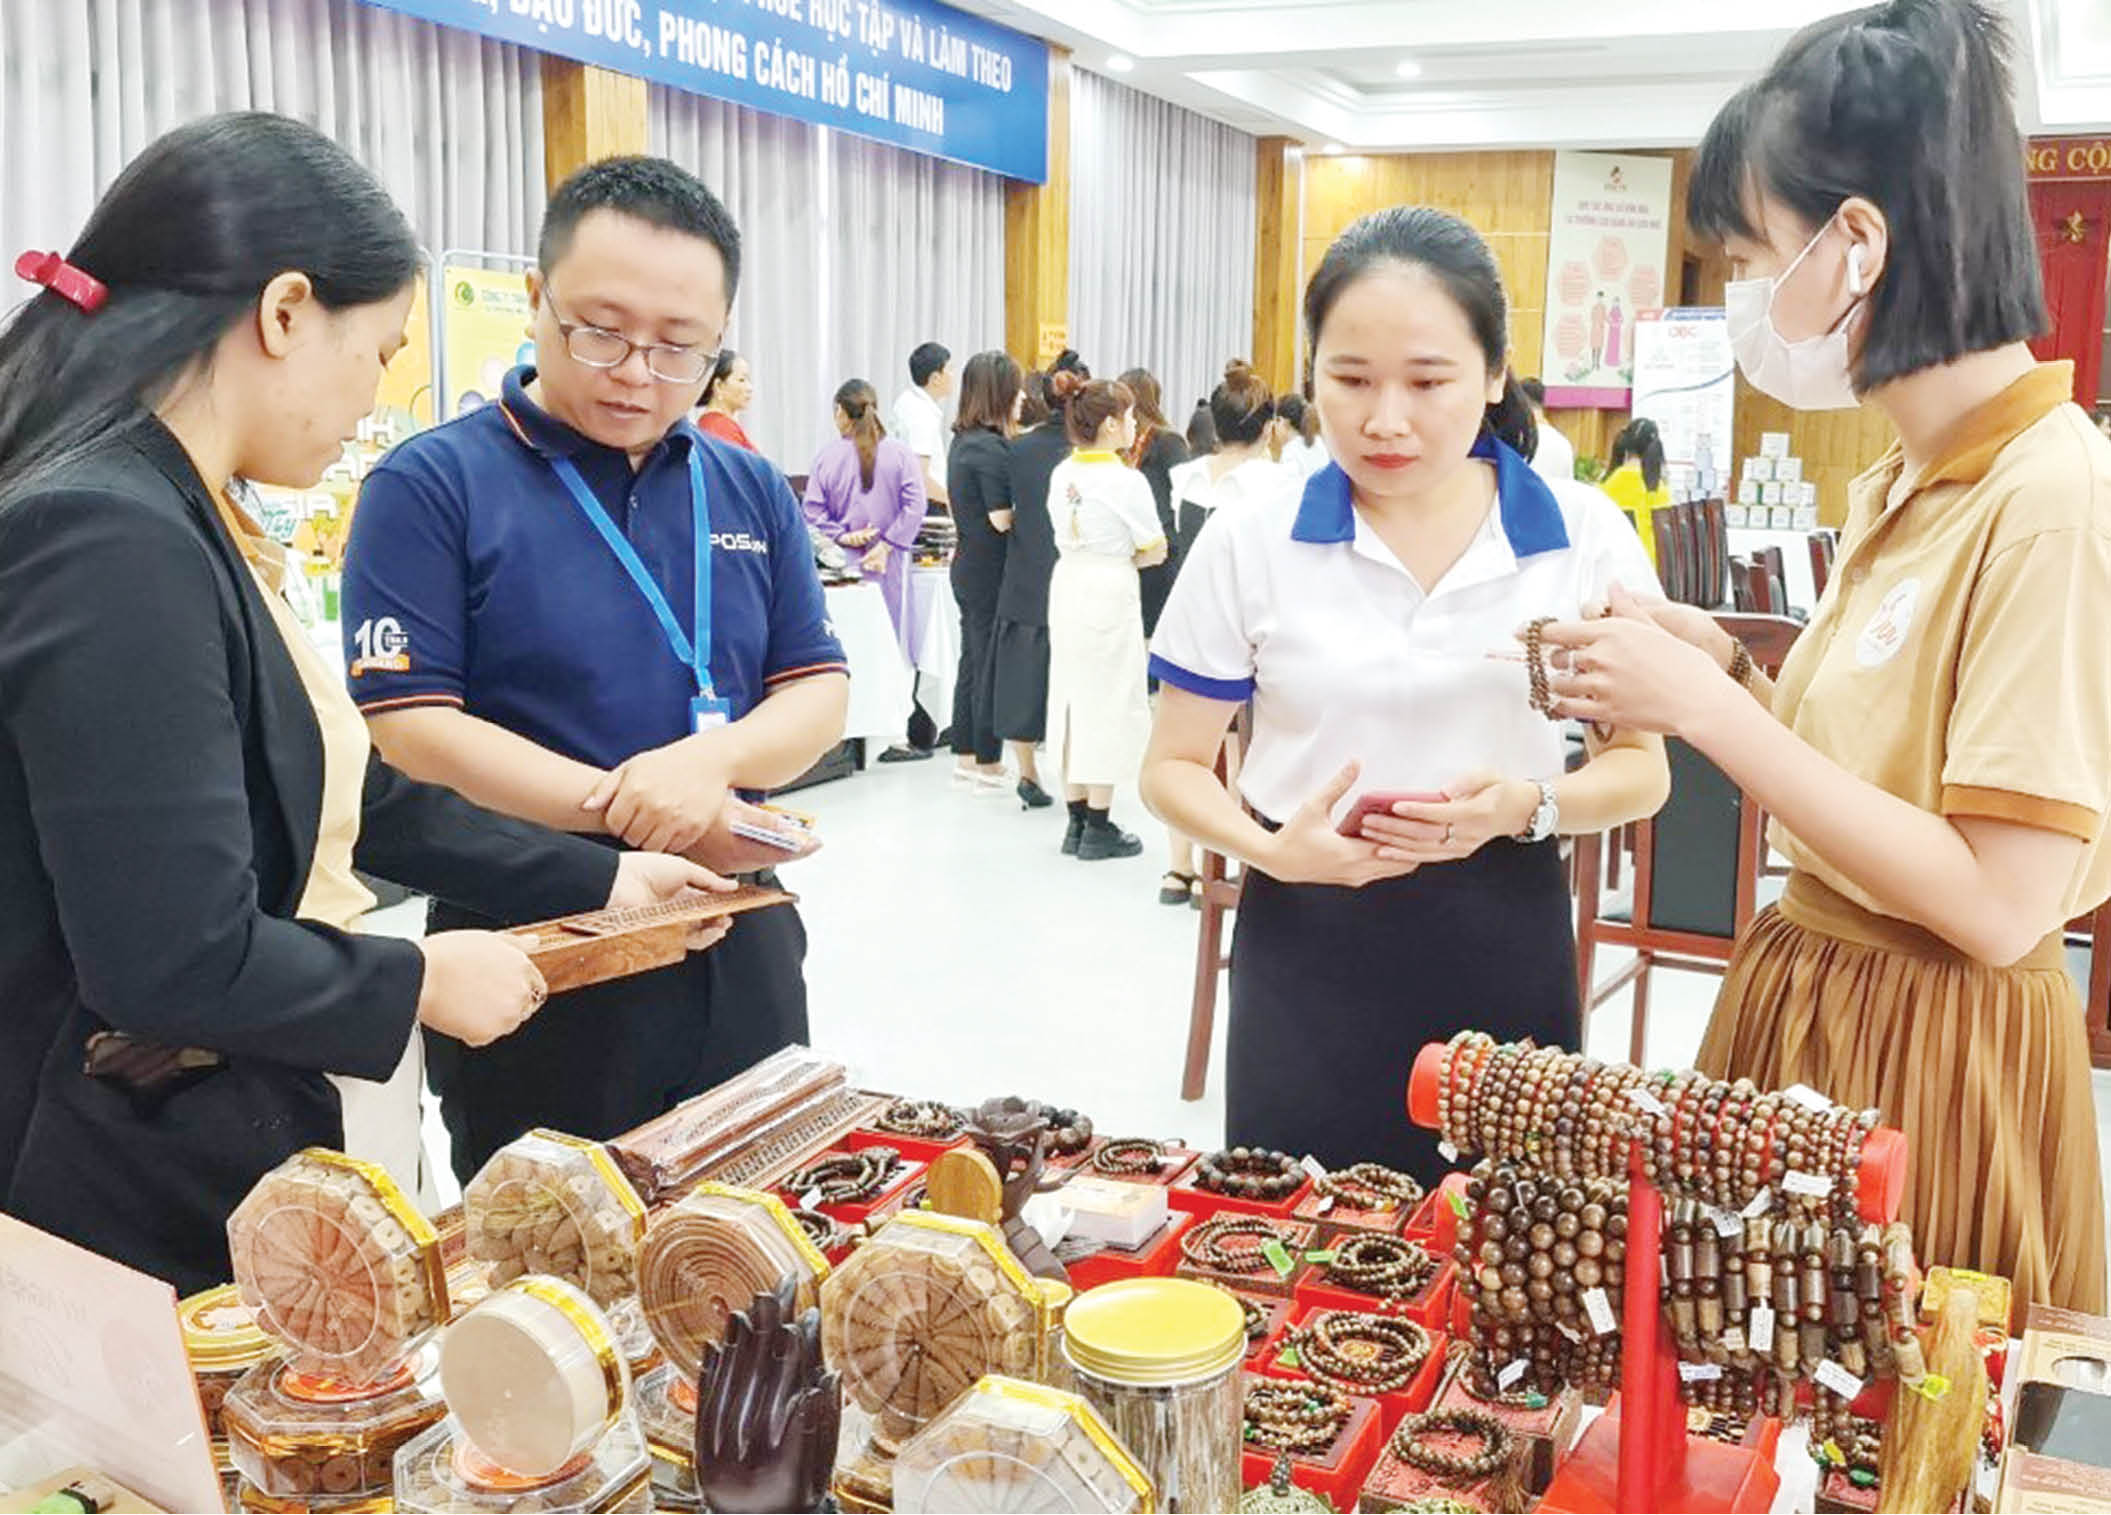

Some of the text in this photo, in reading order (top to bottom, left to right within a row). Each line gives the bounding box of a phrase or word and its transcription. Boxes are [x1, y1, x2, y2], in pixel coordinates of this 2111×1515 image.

[658, 10, 748, 81] PHONG
[753, 36, 816, 100] CÁCH
[854, 70, 890, 121] CHÍ
[893, 82, 945, 137] MINH
[809, 0, 852, 43] HỌC
[857, 0, 895, 57] TẬP
[899, 15, 926, 64] VÀ
[929, 25, 968, 79] LÀM
[970, 43, 1013, 93] THEO
[2066, 141, 2111, 174] CỘ
